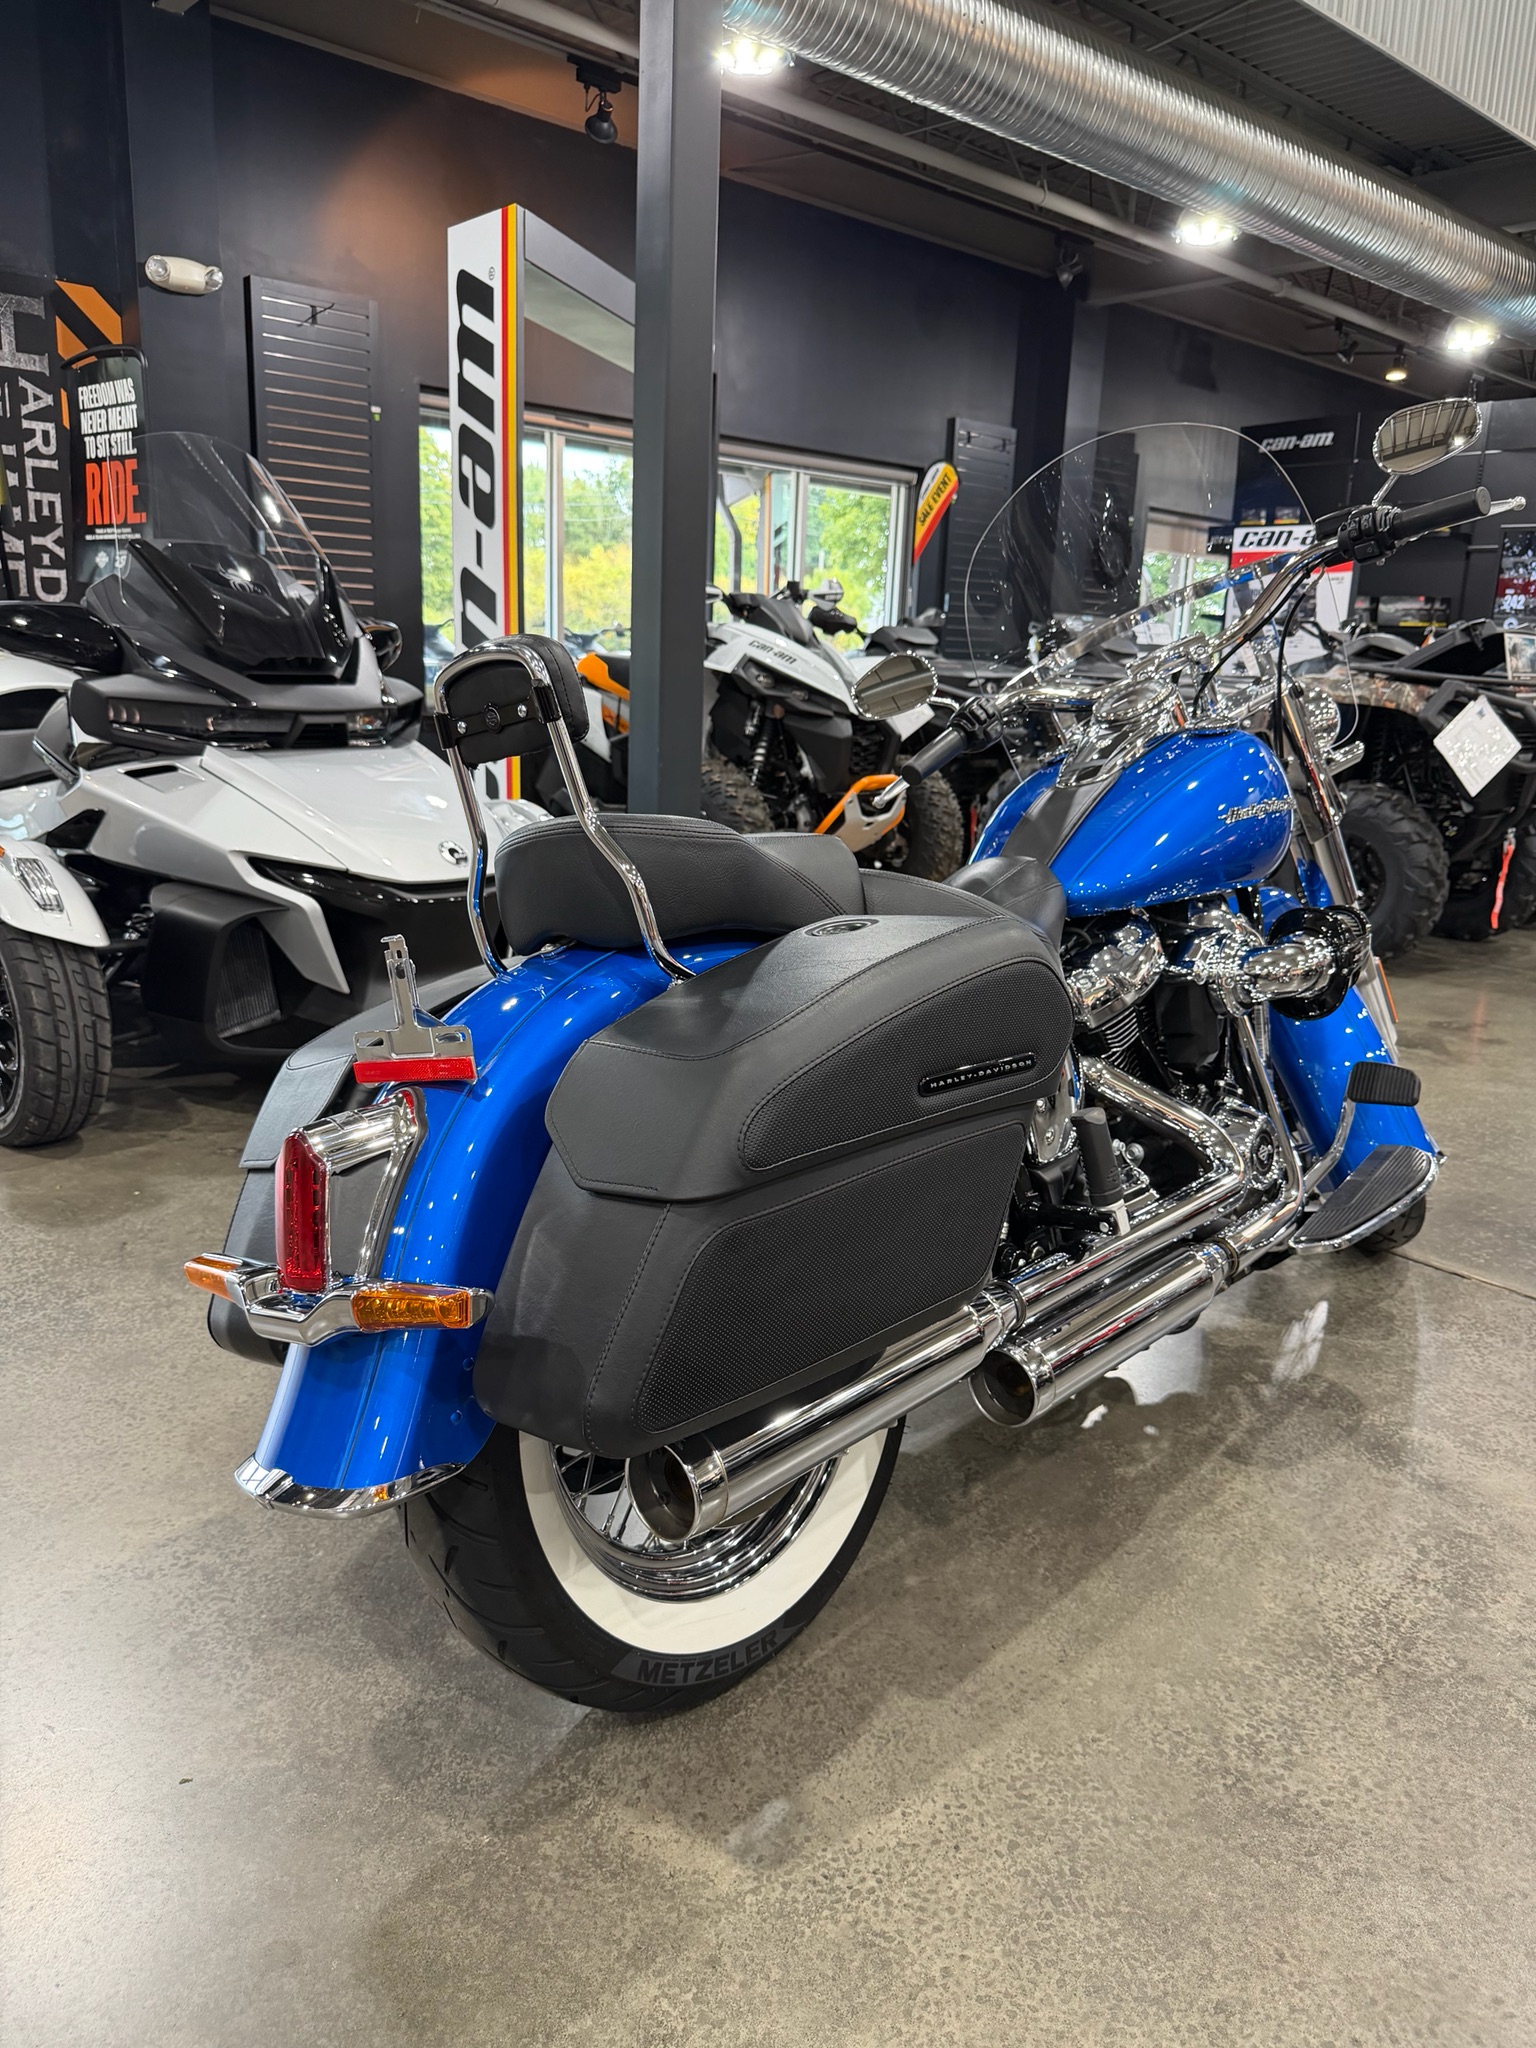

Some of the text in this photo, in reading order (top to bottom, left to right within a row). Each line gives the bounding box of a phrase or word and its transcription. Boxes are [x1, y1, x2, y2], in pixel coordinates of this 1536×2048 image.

[78, 377, 136, 410] FREEDOM WAS
[81, 403, 138, 435] NEVER MEANT
[84, 435, 97, 460] TO
[96, 433, 111, 458] SIT
[85, 458, 147, 526] RIDE.
[918, 502, 935, 527] SALE
[930, 471, 953, 504] EVENT
[1239, 528, 1317, 547] can-a
[748, 640, 797, 664] can-am
[929, 1058, 1032, 1089] HARLEY-DAVIDSON
[636, 1628, 779, 1685] METZELER
